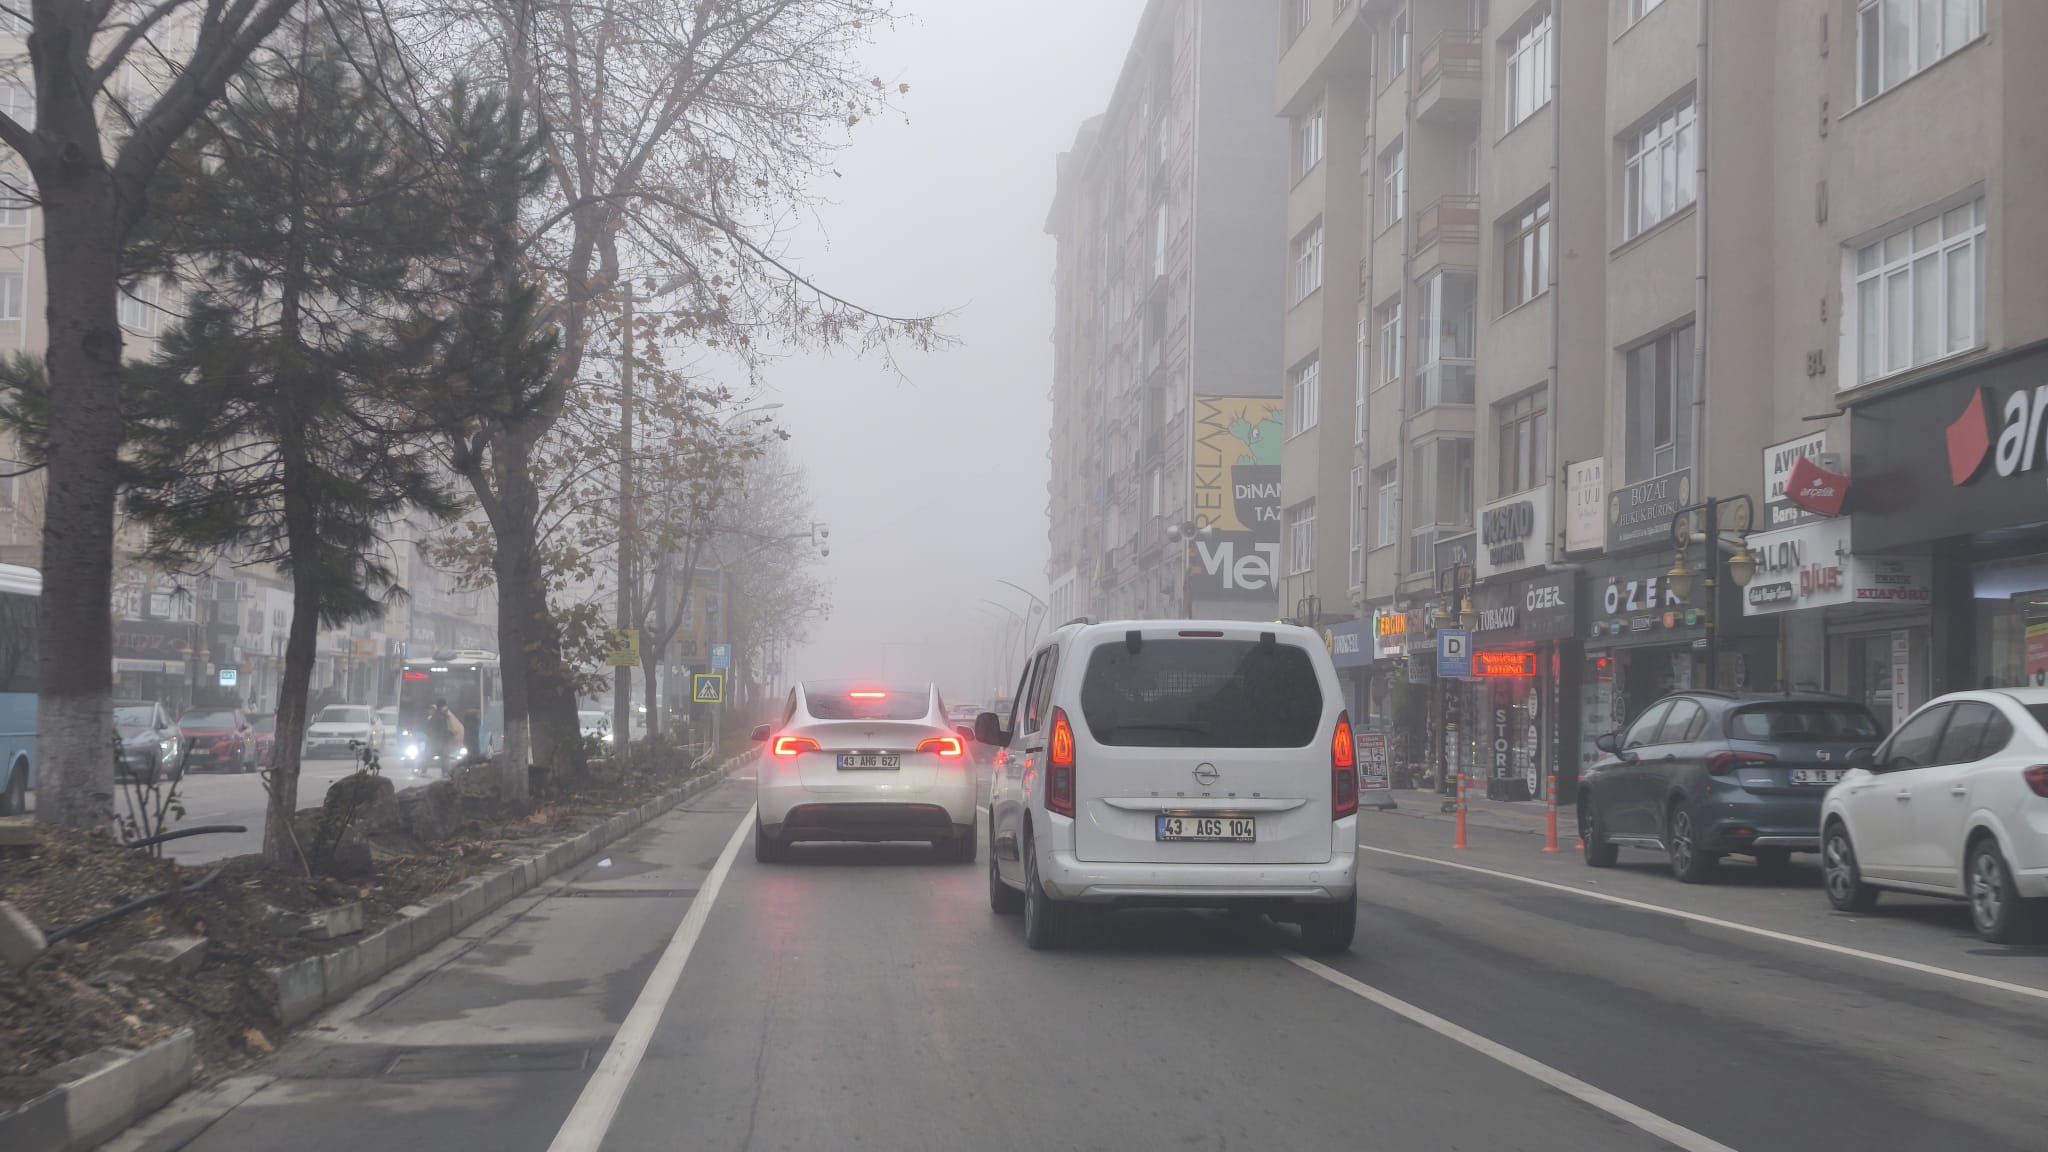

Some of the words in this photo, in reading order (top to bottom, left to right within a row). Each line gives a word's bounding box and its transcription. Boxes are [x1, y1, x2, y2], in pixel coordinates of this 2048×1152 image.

[1995, 385, 2048, 477] ar
[1195, 395, 1224, 529] REKLAM
[1631, 480, 1668, 506] BOZAT
[1800, 487, 1835, 498] arçelik
[1526, 583, 1567, 611] ÖZER
[1480, 606, 1515, 632] TOBACCO
[1448, 638, 1461, 654] D
[1495, 708, 1509, 779] STORE
[844, 756, 855, 767] 43
[860, 756, 877, 767] AHG
[881, 756, 899, 767] 627
[1165, 819, 1183, 836] 43
[1196, 820, 1222, 837] AGS
[1229, 820, 1252, 837] 104
